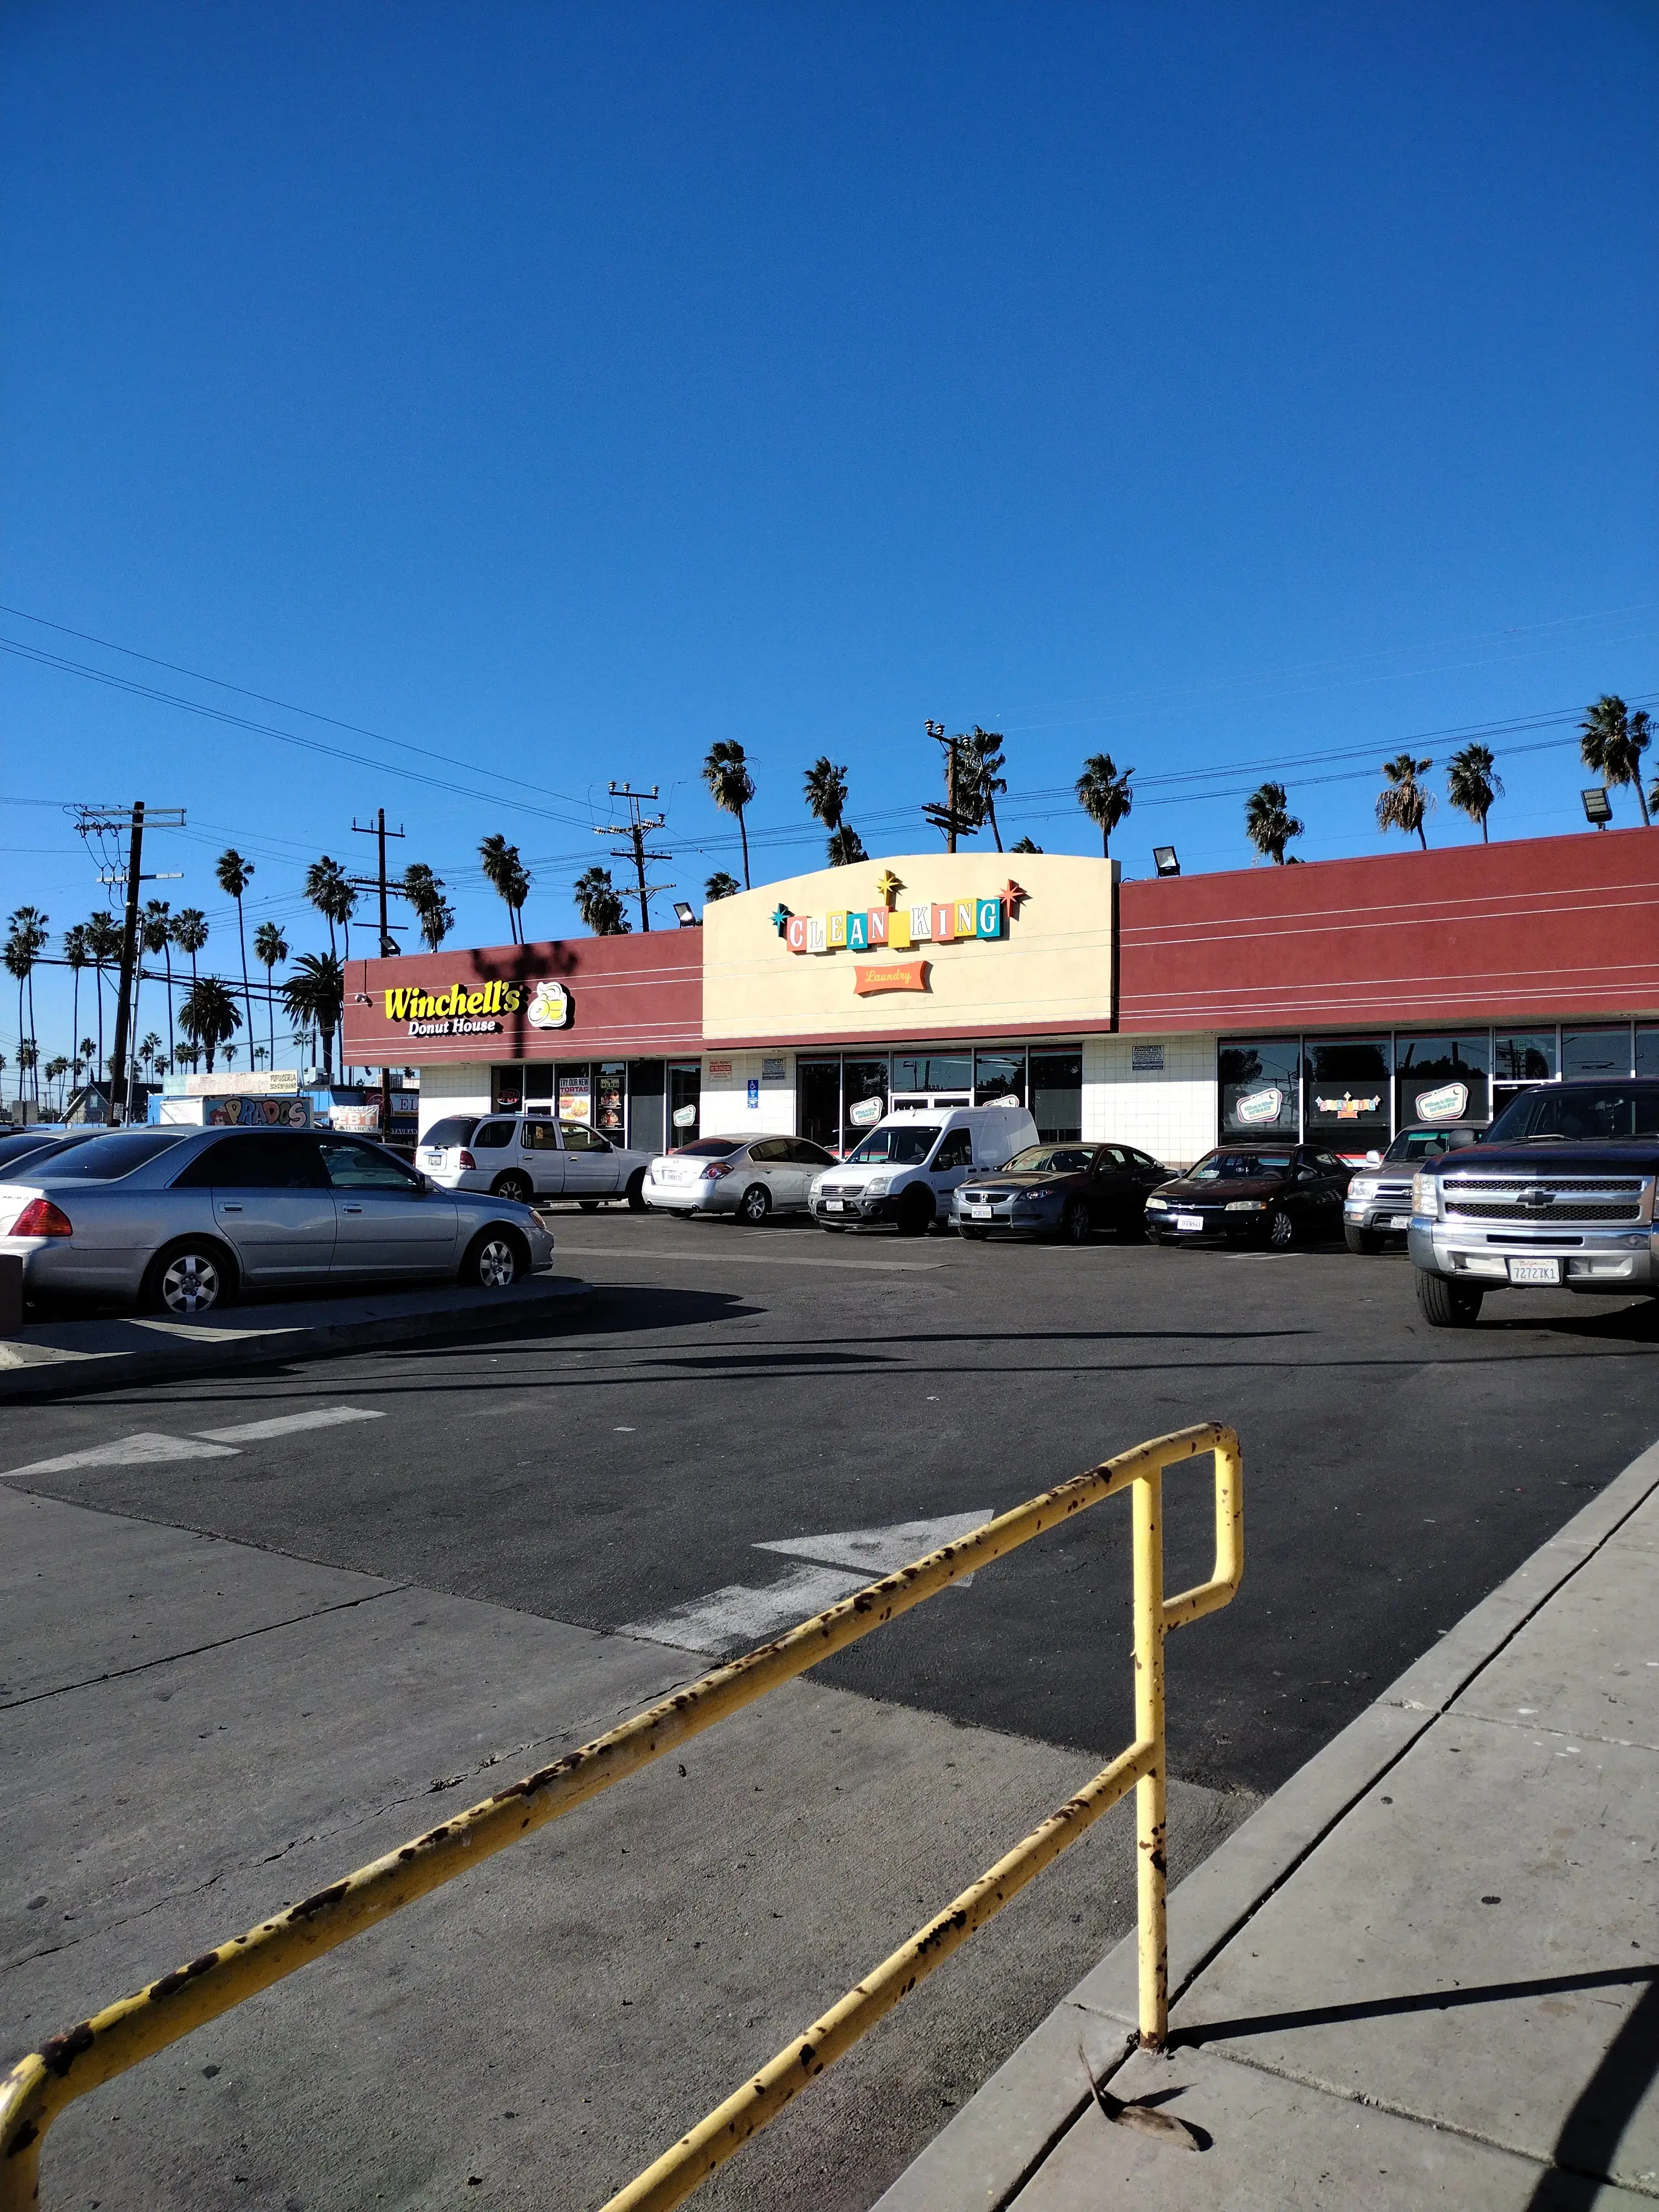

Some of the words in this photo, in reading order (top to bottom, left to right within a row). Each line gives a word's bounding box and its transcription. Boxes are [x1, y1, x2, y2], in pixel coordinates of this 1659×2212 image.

[789, 911, 885, 948] CLEAN
[912, 903, 997, 936] KING
[864, 968, 911, 984] Laundry
[384, 980, 520, 1020] Winchell's
[408, 1021, 449, 1035] Donut
[452, 1019, 495, 1032] House
[270, 1073, 297, 1082] PUPUSERIA
[188, 1082, 216, 1093] BAKERY
[1321, 1100, 1348, 1110] CEAN
[225, 1098, 307, 1128] PRADOS
[336, 1113, 375, 1125] EBT
[1514, 1267, 1556, 1279] 72727K1
